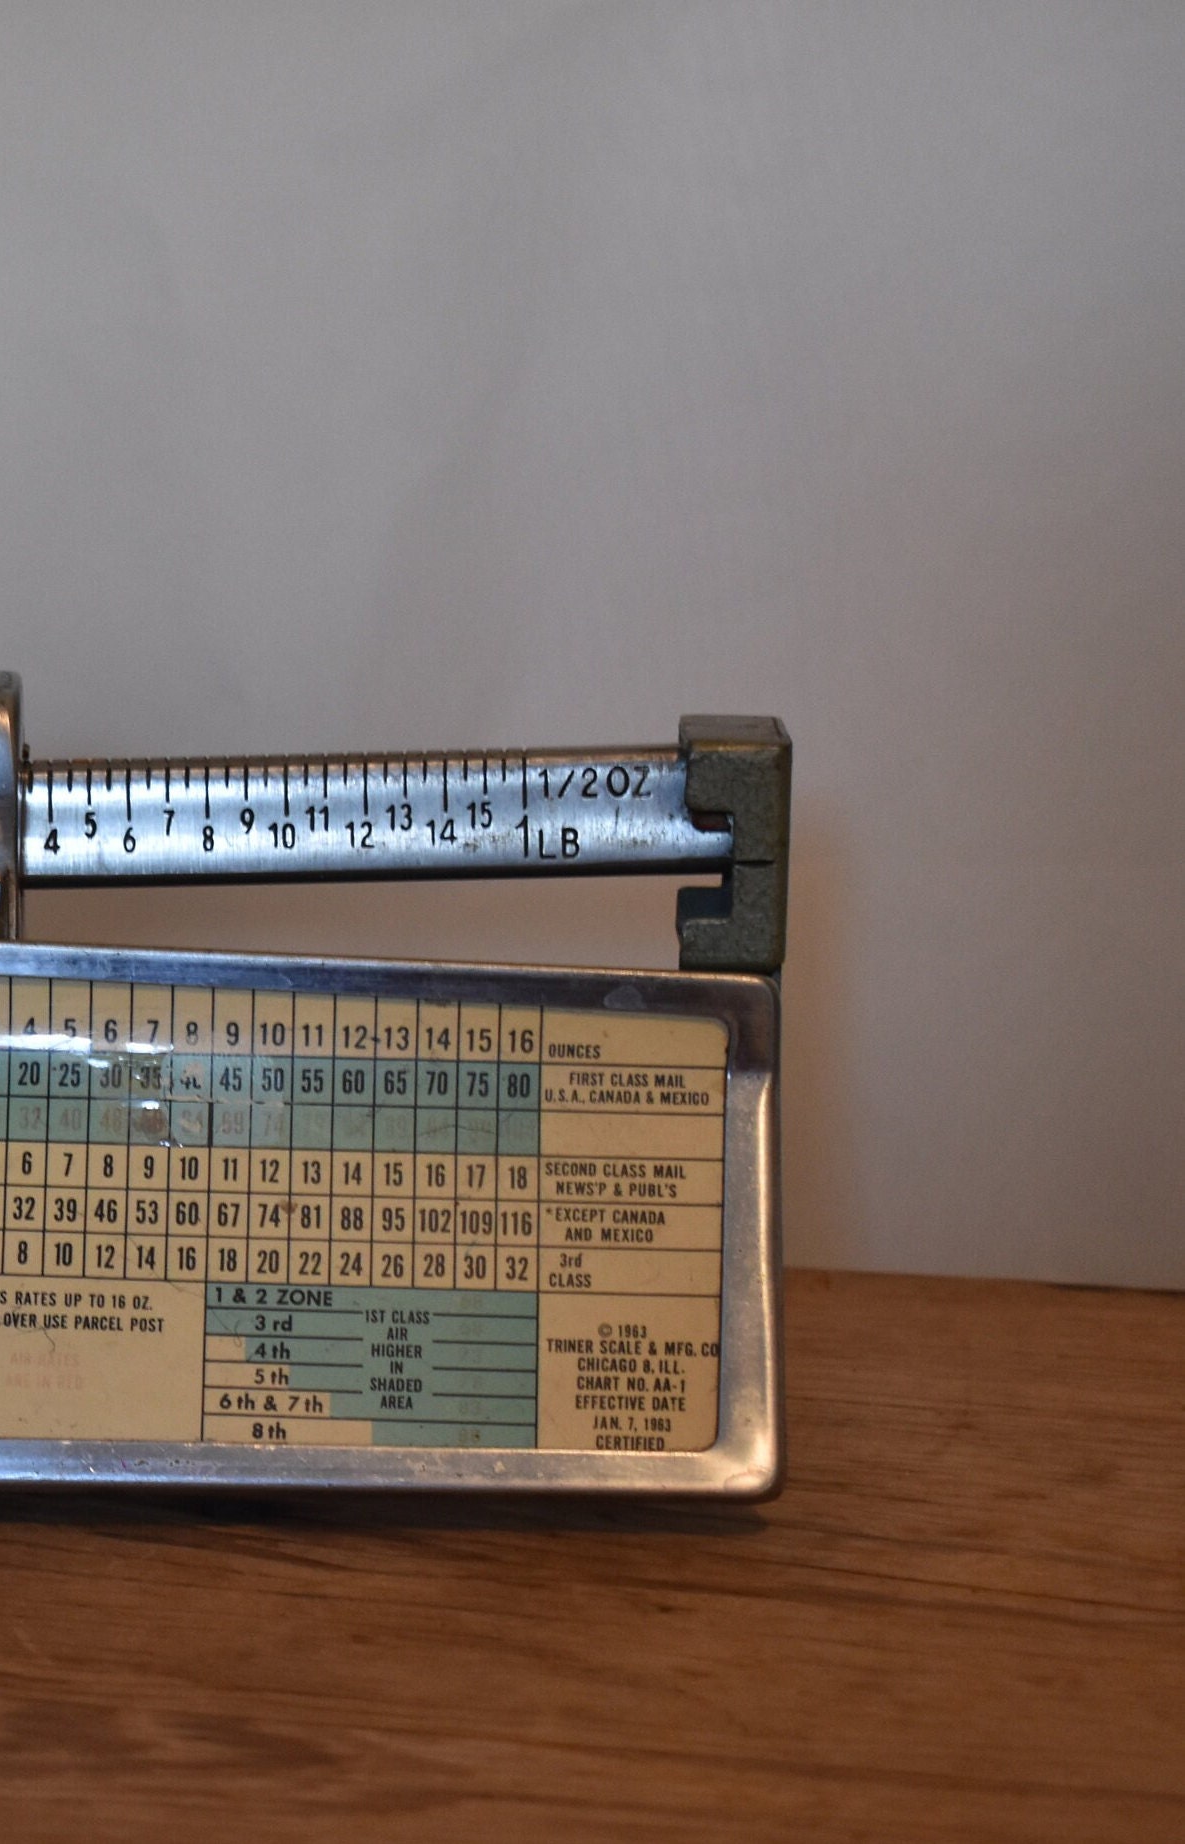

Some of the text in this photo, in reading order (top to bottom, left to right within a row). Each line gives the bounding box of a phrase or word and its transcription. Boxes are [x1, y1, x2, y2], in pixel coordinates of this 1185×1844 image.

[43, 828, 61, 855] 4
[83, 812, 99, 840] 5
[122, 827, 137, 853] 6
[162, 809, 176, 837] 7
[201, 825, 215, 852] 8
[239, 808, 255, 834] 9
[268, 822, 297, 851] 10
[305, 806, 330, 832] 11
[344, 821, 375, 849] 12
[385, 805, 414, 832] 13
[425, 819, 457, 846] 14
[466, 802, 493, 829] 15
[104, 1019, 534, 1054] 6 9 10 11 12 13 14 15 16
[548, 1043, 601, 1059] OUNCES
[18, 1062, 40, 1087] 20
[59, 1063, 81, 1088] 25
[219, 1066, 243, 1092] 45
[261, 1067, 284, 1093] 50
[301, 1068, 324, 1094] 55
[342, 1069, 365, 1094] 60
[384, 1070, 407, 1095] 65
[425, 1071, 449, 1096] 70
[467, 1072, 489, 1098] 75
[507, 1073, 531, 1098] 80
[569, 1072, 686, 1089] FIRST CLASS MAIL
[589, 1091, 641, 1105] CANADA
[646, 1091, 655, 1105] &
[660, 1092, 710, 1106] MEXICO
[21, 1152, 32, 1174] 6
[103, 1155, 114, 1177] 8
[179, 1156, 199, 1180] 10
[343, 1162, 363, 1185] 14
[425, 1163, 446, 1187] 16
[466, 1165, 486, 1189] 17
[508, 1166, 528, 1189] 18
[545, 1162, 687, 1180] SECOND CLASS MAIL
[556, 1182, 677, 1198] NEWS'P & PUBL'S
[54, 1198, 78, 1222] 39
[217, 1203, 240, 1227] 67
[300, 1206, 323, 1229] 81
[382, 1207, 406, 1232] 95
[419, 1208, 451, 1234] 102
[460, 1210, 493, 1235] 109
[501, 1211, 533, 1236] 116
[612, 1210, 666, 1225] CANADA
[565, 1228, 654, 1243] AND MEXICO
[54, 1243, 73, 1267] 10
[136, 1246, 156, 1270] 14
[218, 1249, 238, 1272] 18
[299, 1251, 322, 1275] 22
[381, 1254, 404, 1279] 26
[423, 1255, 446, 1277] 28
[464, 1256, 486, 1279] 30
[505, 1256, 529, 1281] 32
[559, 1253, 582, 1268] 3rd
[549, 1273, 592, 1288] CLASS
[15, 1291, 56, 1307] RATES
[64, 1292, 82, 1308] UP
[89, 1293, 105, 1309] TO
[111, 1294, 126, 1309] 16
[215, 1287, 333, 1307] 1 & 2 ZONE
[3, 1313, 37, 1329] OVER
[43, 1314, 68, 1330] USE
[74, 1315, 123, 1331] PARCEL
[130, 1316, 165, 1333] POST
[392, 1310, 430, 1325] CLASS
[387, 1328, 408, 1341] AIR
[618, 1324, 648, 1339] 1963
[371, 1344, 422, 1359] HIGHER
[546, 1338, 594, 1354] TRINER
[599, 1340, 642, 1356] SCALE
[648, 1341, 657, 1356] &
[664, 1342, 697, 1357] MFG.
[390, 1361, 403, 1374] IN
[577, 1357, 637, 1372] CHICAGO
[370, 1378, 422, 1393] SHADED
[576, 1376, 620, 1391] CHART
[263, 1396, 277, 1412] &
[380, 1396, 413, 1410] AREA
[575, 1395, 686, 1412] EFFECTIVE DATE
[644, 1418, 671, 1432] 1963
[595, 1435, 665, 1450] CERTIFIED
